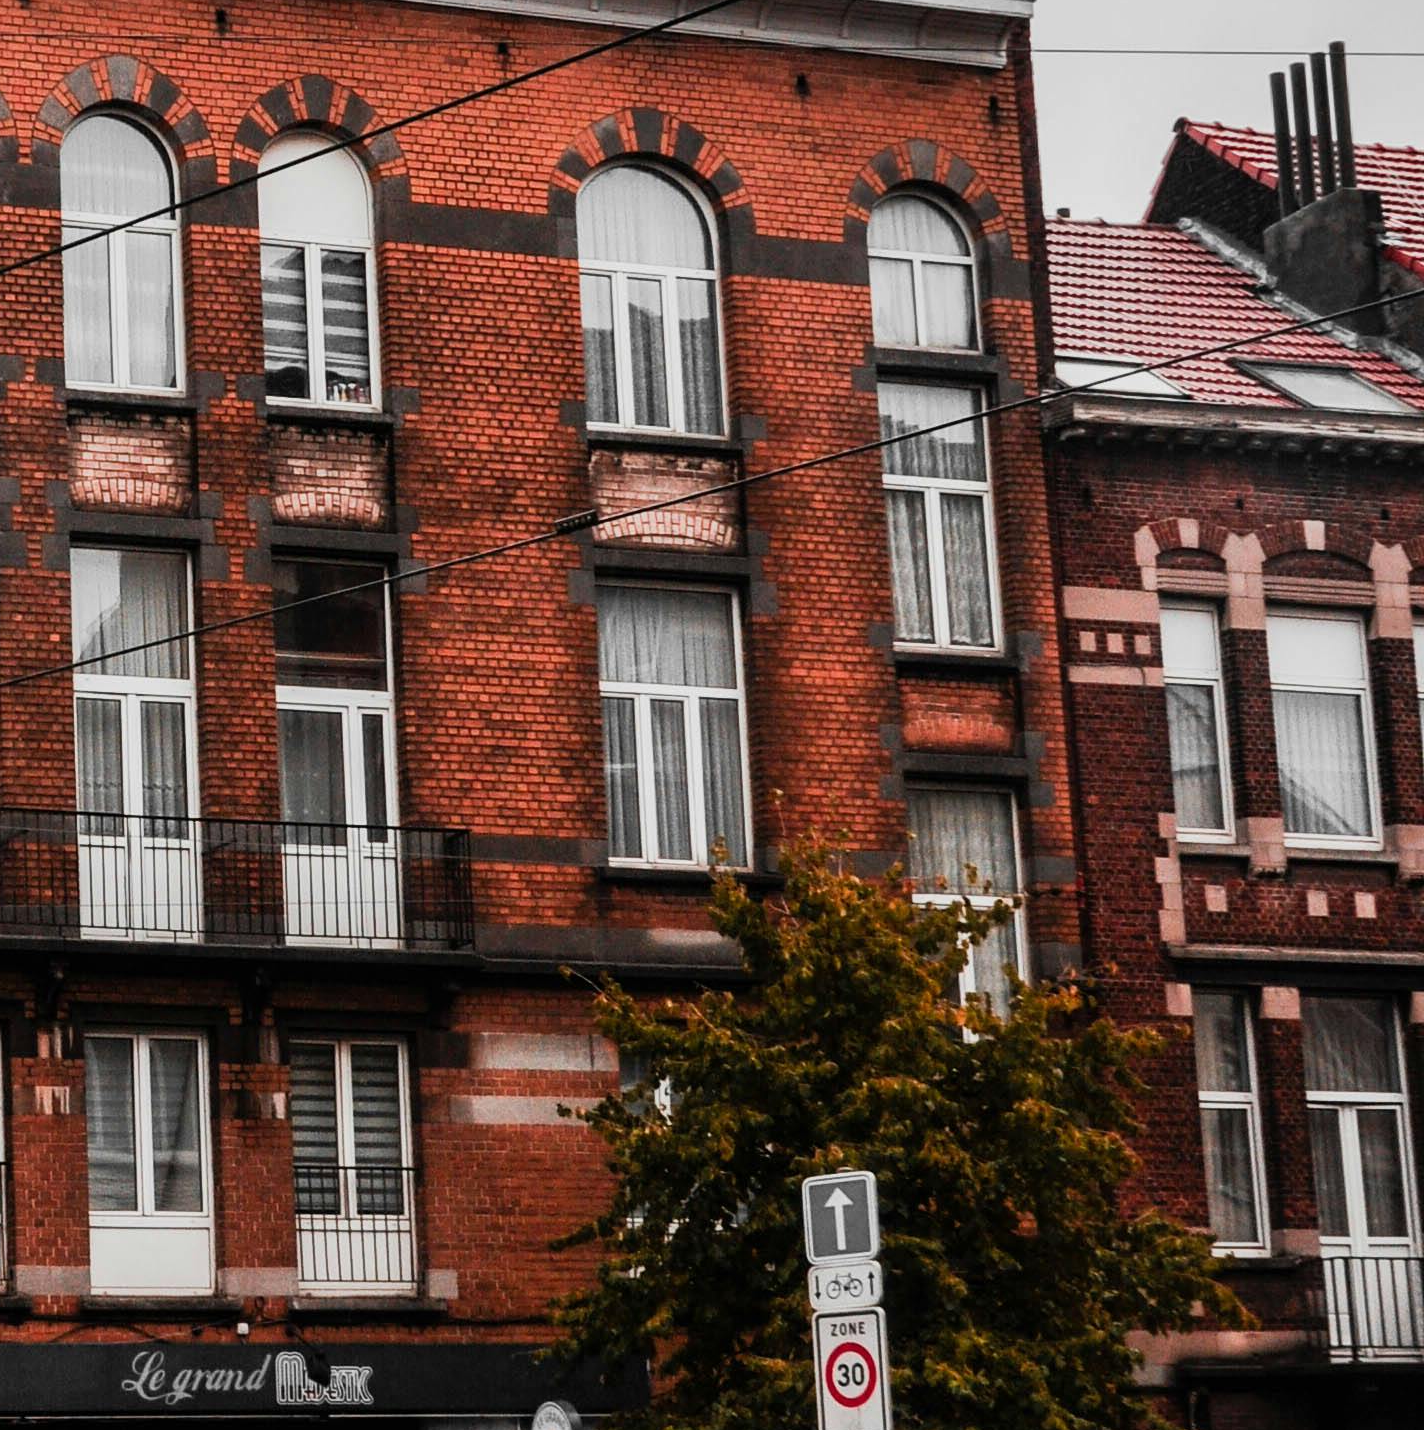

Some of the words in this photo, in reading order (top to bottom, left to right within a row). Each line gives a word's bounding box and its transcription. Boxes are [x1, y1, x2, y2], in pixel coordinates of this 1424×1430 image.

[830, 1322, 866, 1337] ZONE
[122, 1351, 167, 1402] Le
[166, 1354, 272, 1405] grand
[838, 1363, 865, 1387] 30
